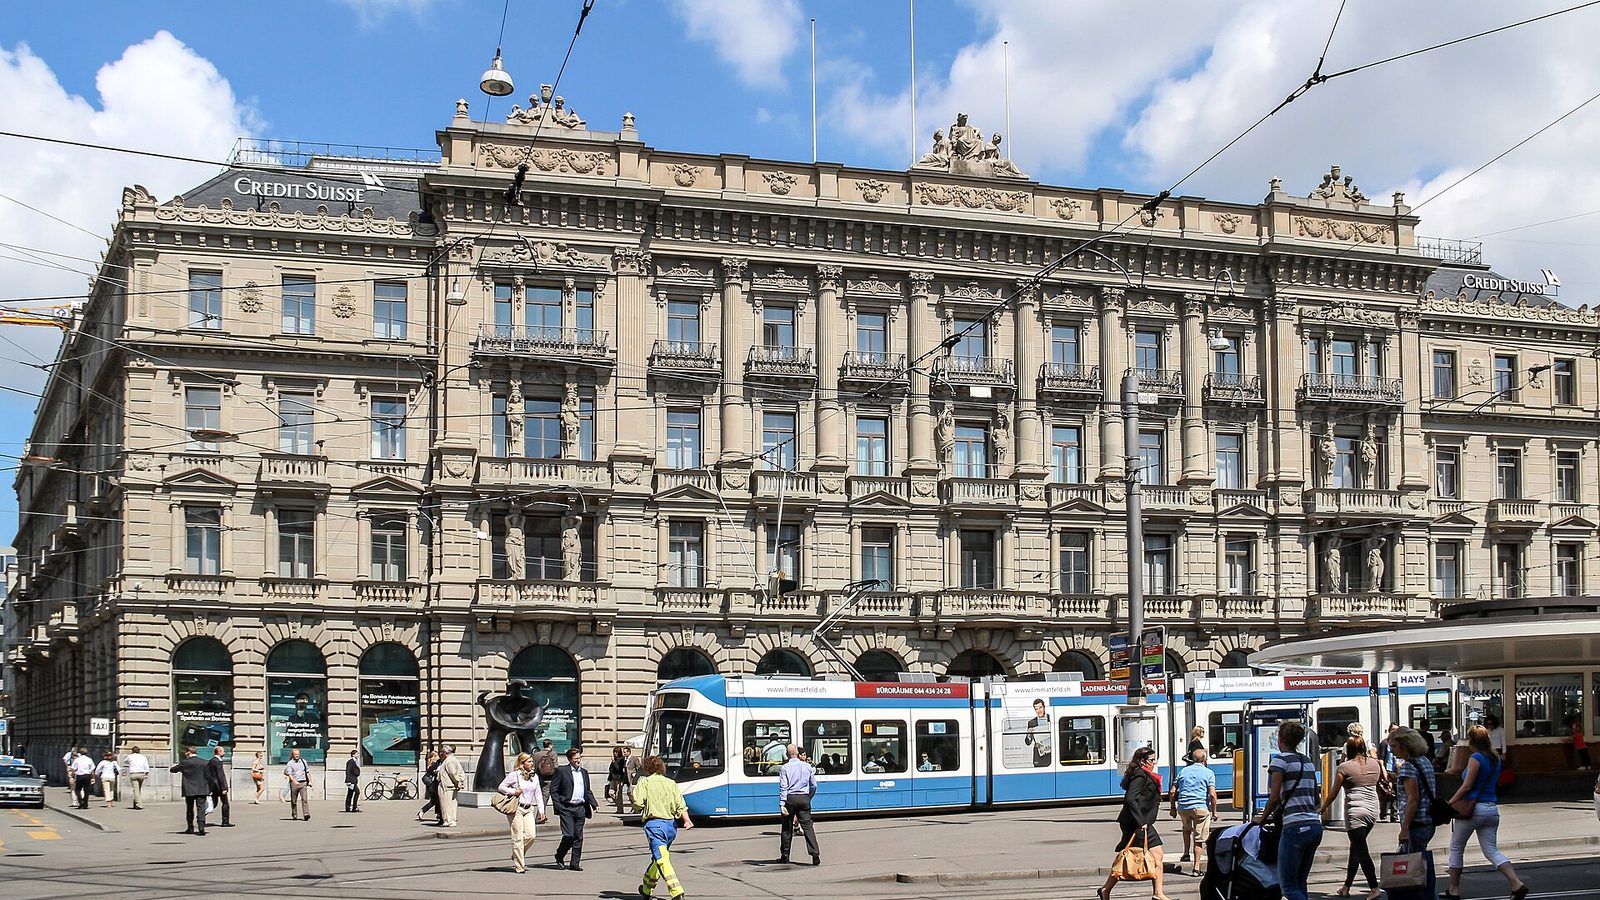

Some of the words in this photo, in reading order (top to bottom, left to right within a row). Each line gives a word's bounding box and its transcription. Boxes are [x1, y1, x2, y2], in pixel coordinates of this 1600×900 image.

[234, 177, 303, 198] CREDIT
[305, 181, 365, 202] SUISSE
[1463, 273, 1509, 291] CREDIT
[1510, 278, 1548, 295] SUISSE
[1400, 675, 1425, 683] HAYS
[766, 685, 827, 693] www.limmatfeld.ch
[876, 686, 913, 694] BÜRORÄUME
[1082, 684, 1127, 692] LADENFLÄCHEN
[92, 722, 108, 730] TAXI
